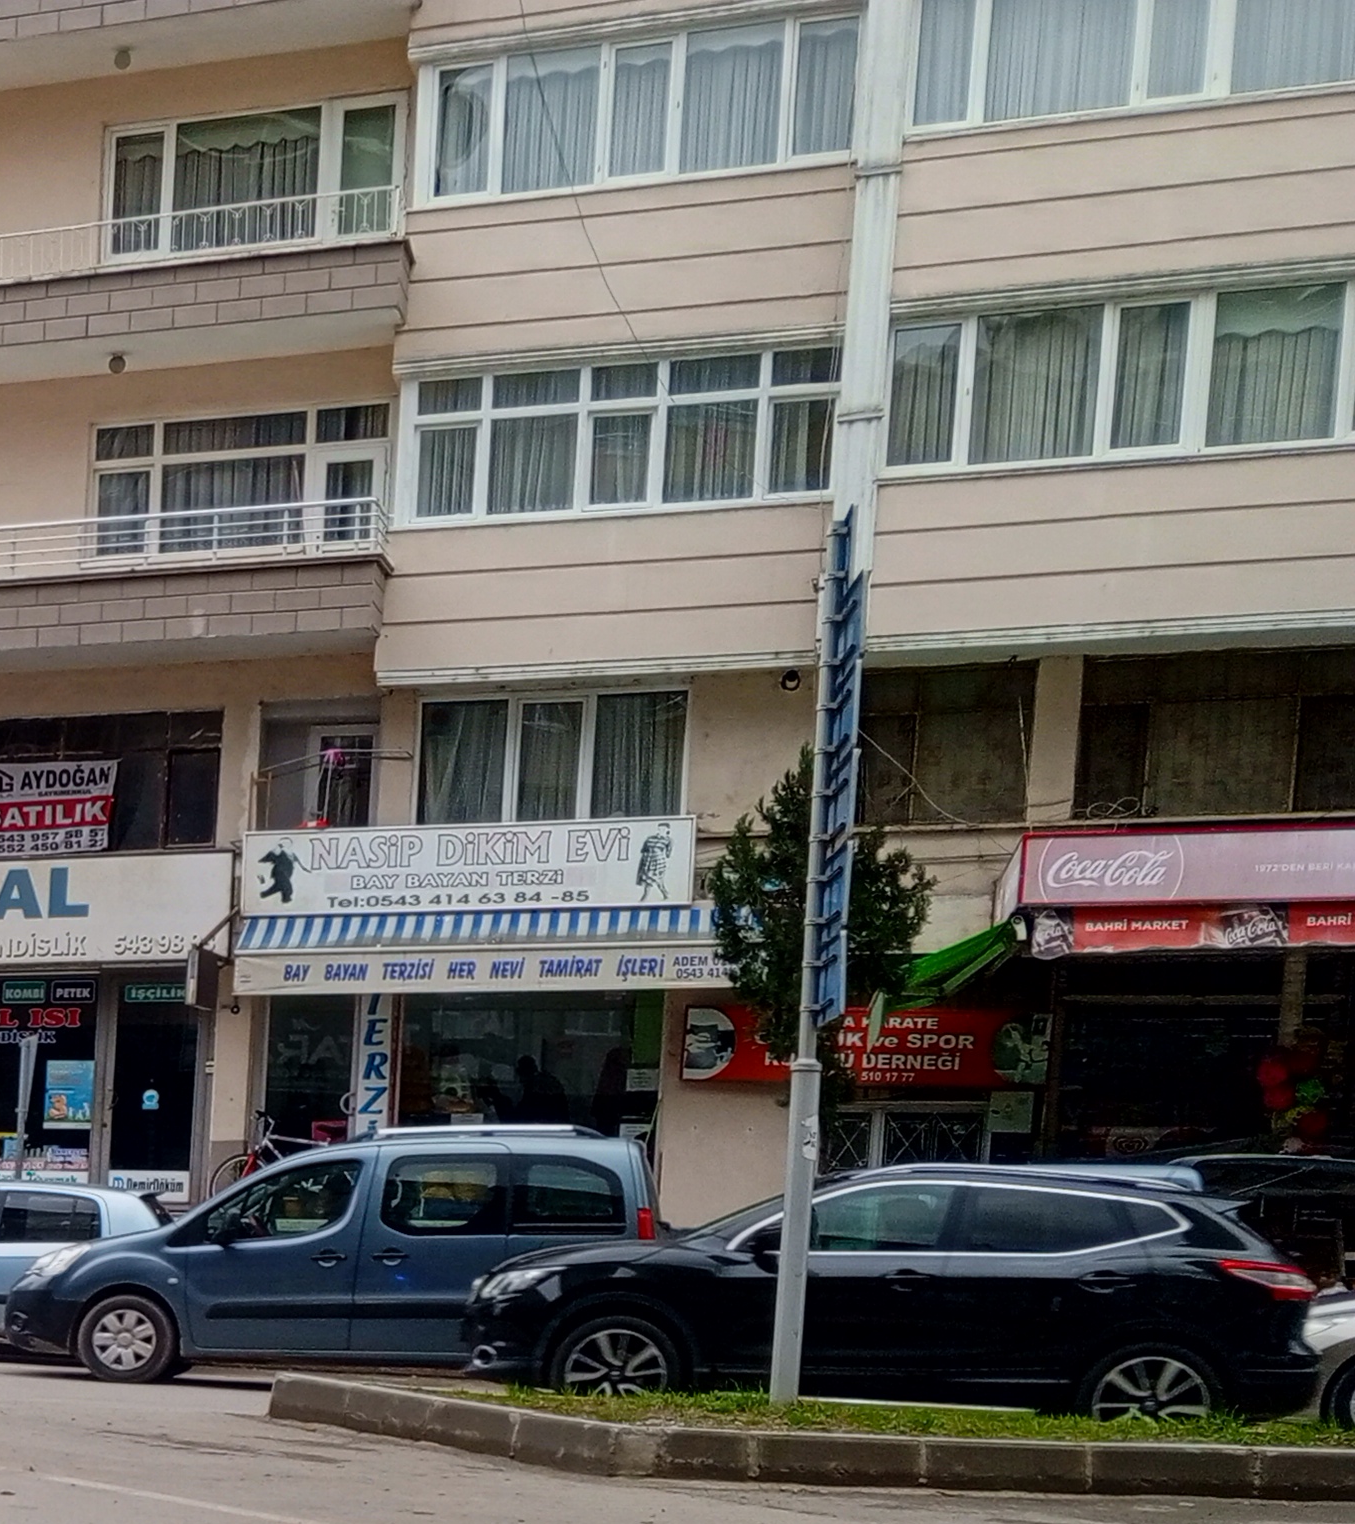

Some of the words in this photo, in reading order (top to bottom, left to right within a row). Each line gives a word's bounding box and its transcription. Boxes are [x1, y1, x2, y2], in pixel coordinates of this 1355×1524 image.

[20, 764, 112, 791] AYDOĞAN
[30, 832, 60, 842] 957
[64, 829, 83, 840] 58
[30, 842, 59, 852] 450
[64, 840, 82, 850] 81
[308, 835, 423, 870] NASİP
[436, 830, 551, 867] DİKİM
[566, 826, 631, 863] EVİ
[1047, 850, 1174, 888] Coca-Cola
[1254, 863, 1305, 874] 1972'DEN
[1307, 862, 1334, 873] BERİ
[1336, 862, 1355, 872] KA
[350, 873, 399, 890] BAY
[405, 871, 490, 889] BAYAN
[495, 869, 564, 886] TERZİ
[326, 892, 422, 908] Tel:0543
[428, 893, 473, 907] 414
[479, 892, 507, 905] 63
[513, 891, 542, 904] 84
[1085, 918, 1128, 932] BAHRİ
[1130, 920, 1190, 931] MARKET
[1306, 913, 1353, 927] BAHRİ
[113, 935, 154, 956] 543
[283, 964, 311, 982] BAY
[324, 963, 369, 982] BAYAN
[382, 959, 435, 982] TERZİSİ
[447, 961, 477, 980] HER
[489, 957, 526, 980] NEVİ
[539, 955, 603, 979] TAMİRAT
[616, 954, 666, 981] İŞLERİ
[673, 956, 709, 967] ADEM
[676, 968, 704, 979] 0543
[5, 986, 45, 999] KOMBİ
[55, 986, 92, 999] PETEK
[27, 1007, 82, 1028] ISI
[906, 1034, 975, 1049] SPOR
[861, 1053, 960, 1070] DERNEĞİ
[861, 1072, 882, 1081] 510
[886, 1072, 899, 1081] 17
[126, 1178, 184, 1194] DemirDöküm
